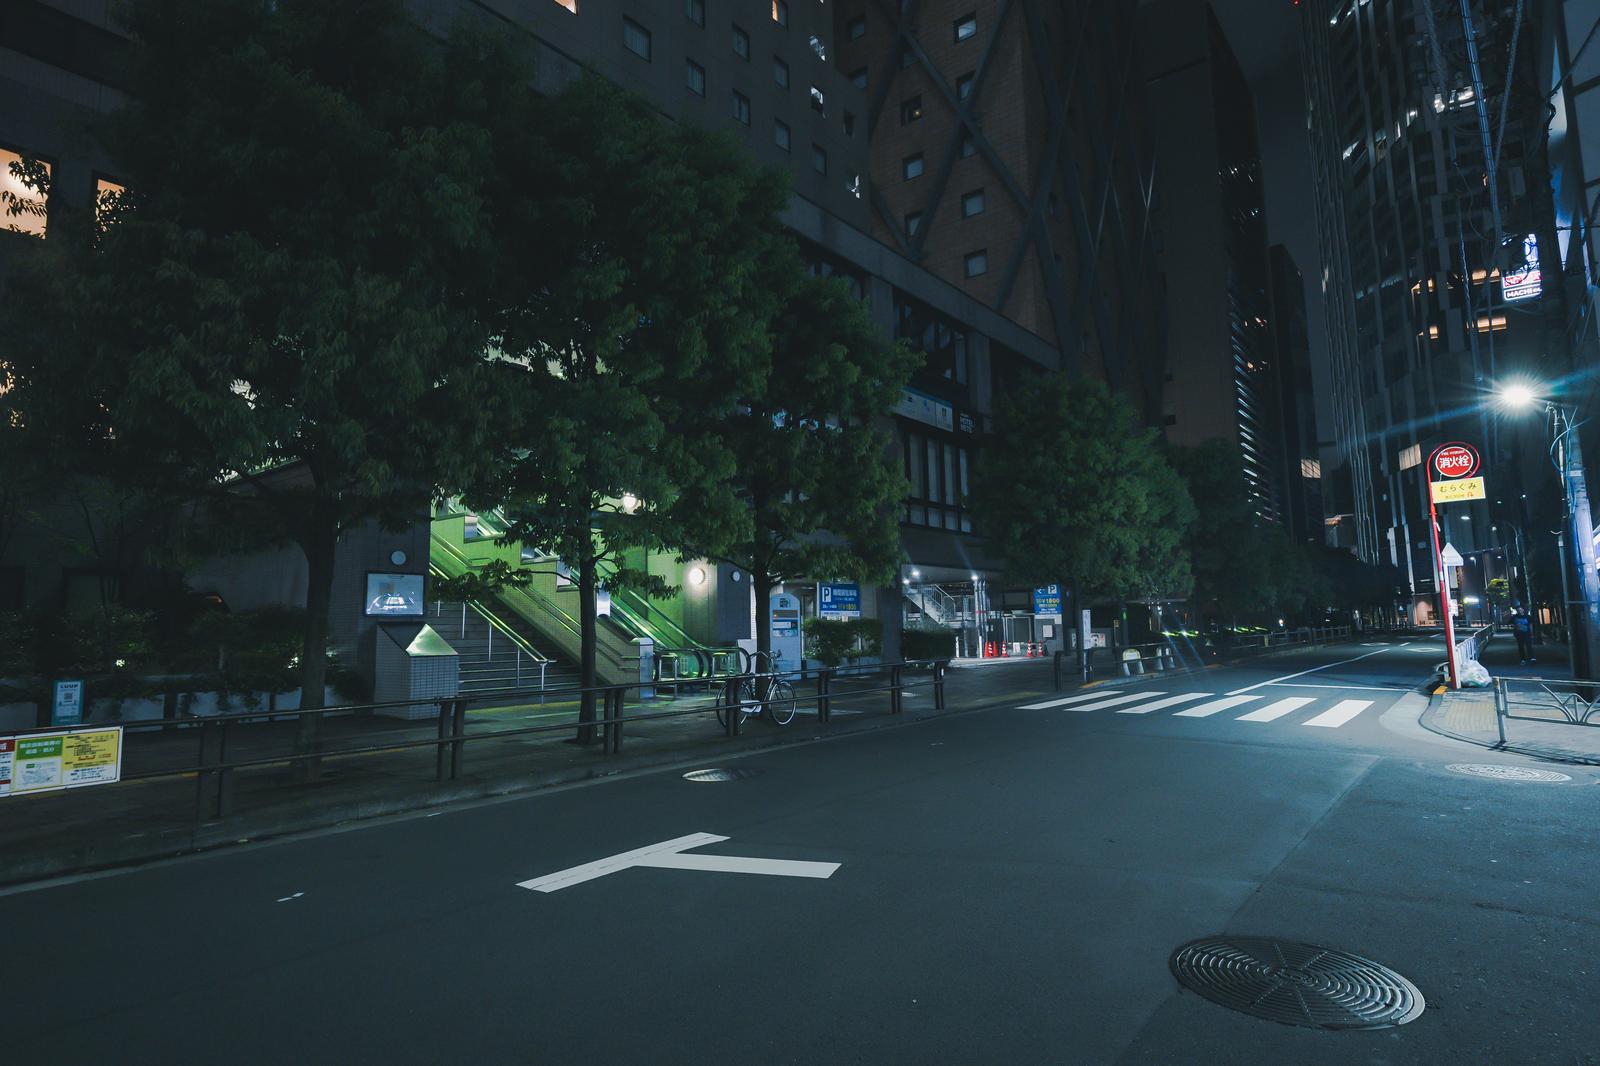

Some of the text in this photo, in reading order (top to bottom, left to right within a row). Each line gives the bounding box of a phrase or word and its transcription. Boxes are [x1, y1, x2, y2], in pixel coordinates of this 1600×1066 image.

[1507, 288, 1532, 297] MACHI
[1439, 455, 1469, 468] 消火栓
